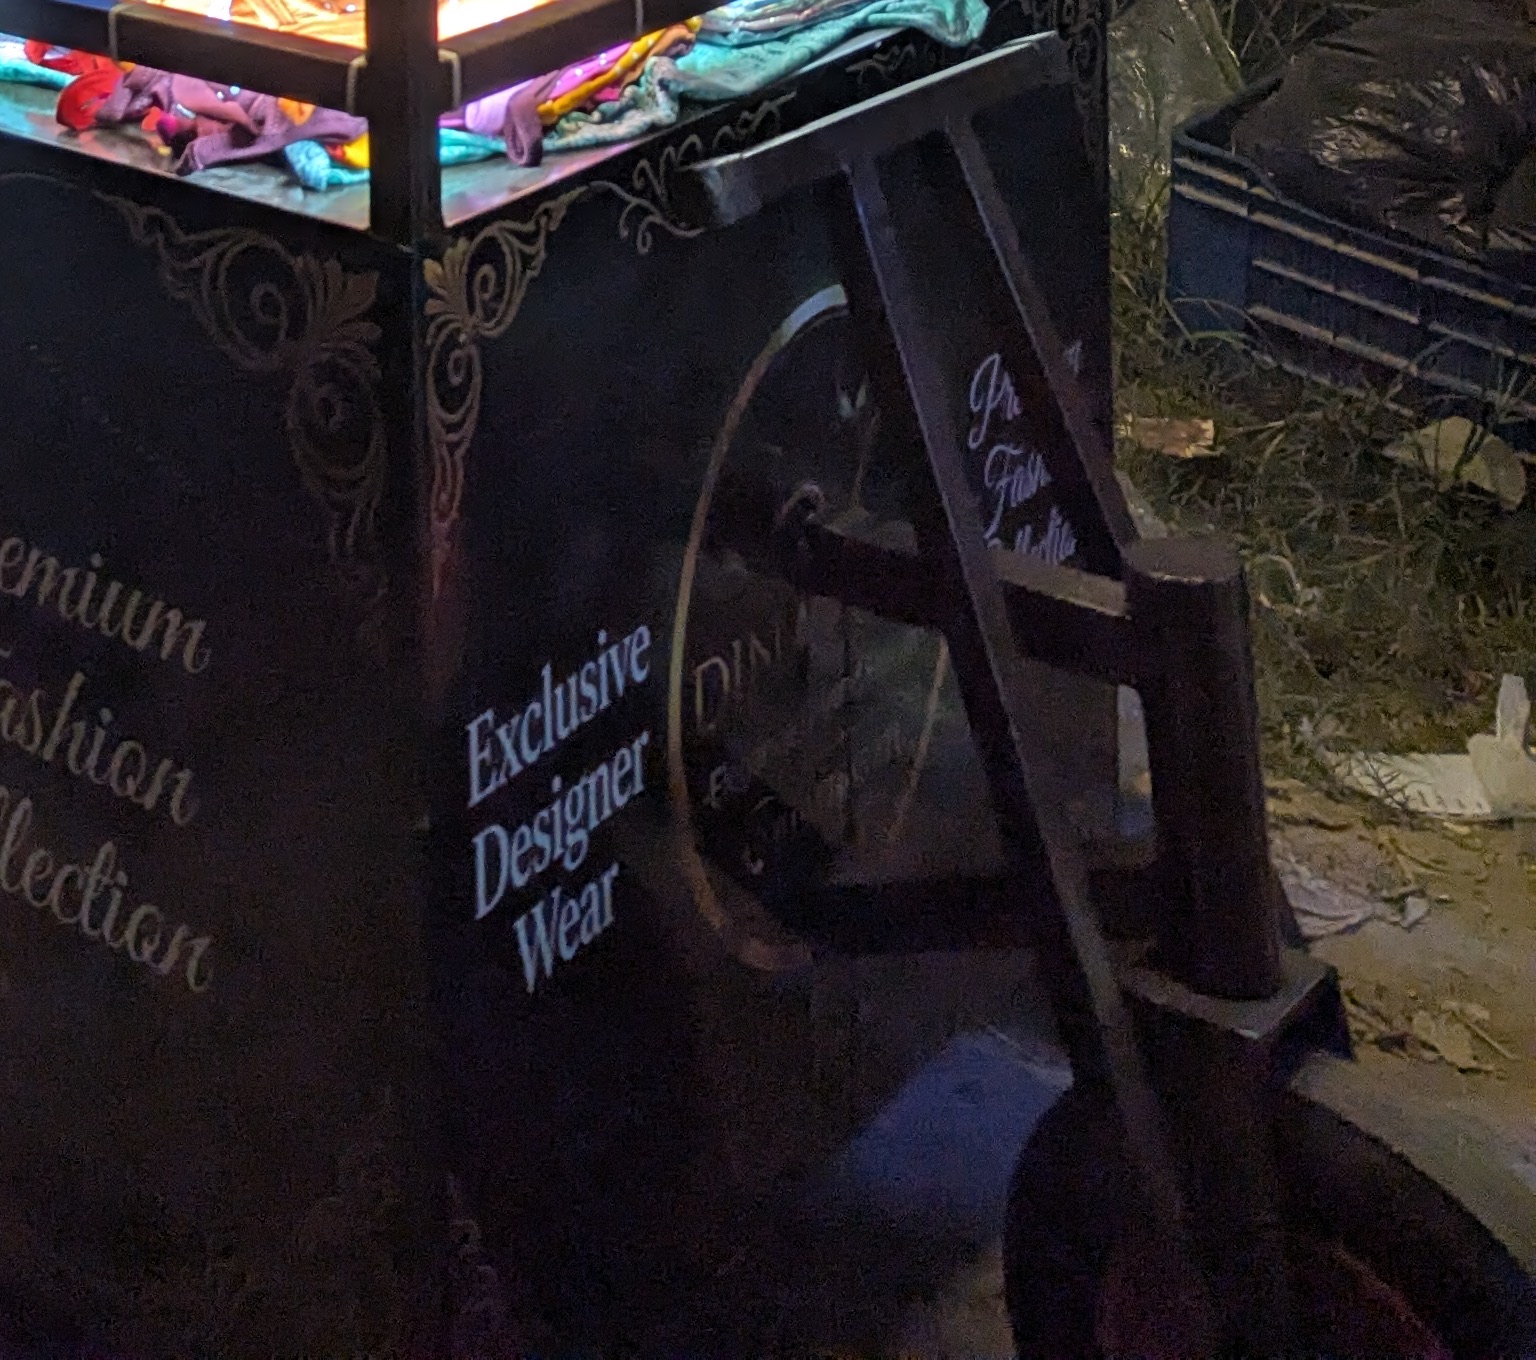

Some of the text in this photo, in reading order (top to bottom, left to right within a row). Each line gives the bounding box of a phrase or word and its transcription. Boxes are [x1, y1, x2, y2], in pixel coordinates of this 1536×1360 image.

[466, 624, 652, 810] Exclusive
[472, 731, 651, 921] Designer
[512, 863, 621, 994] Wear
